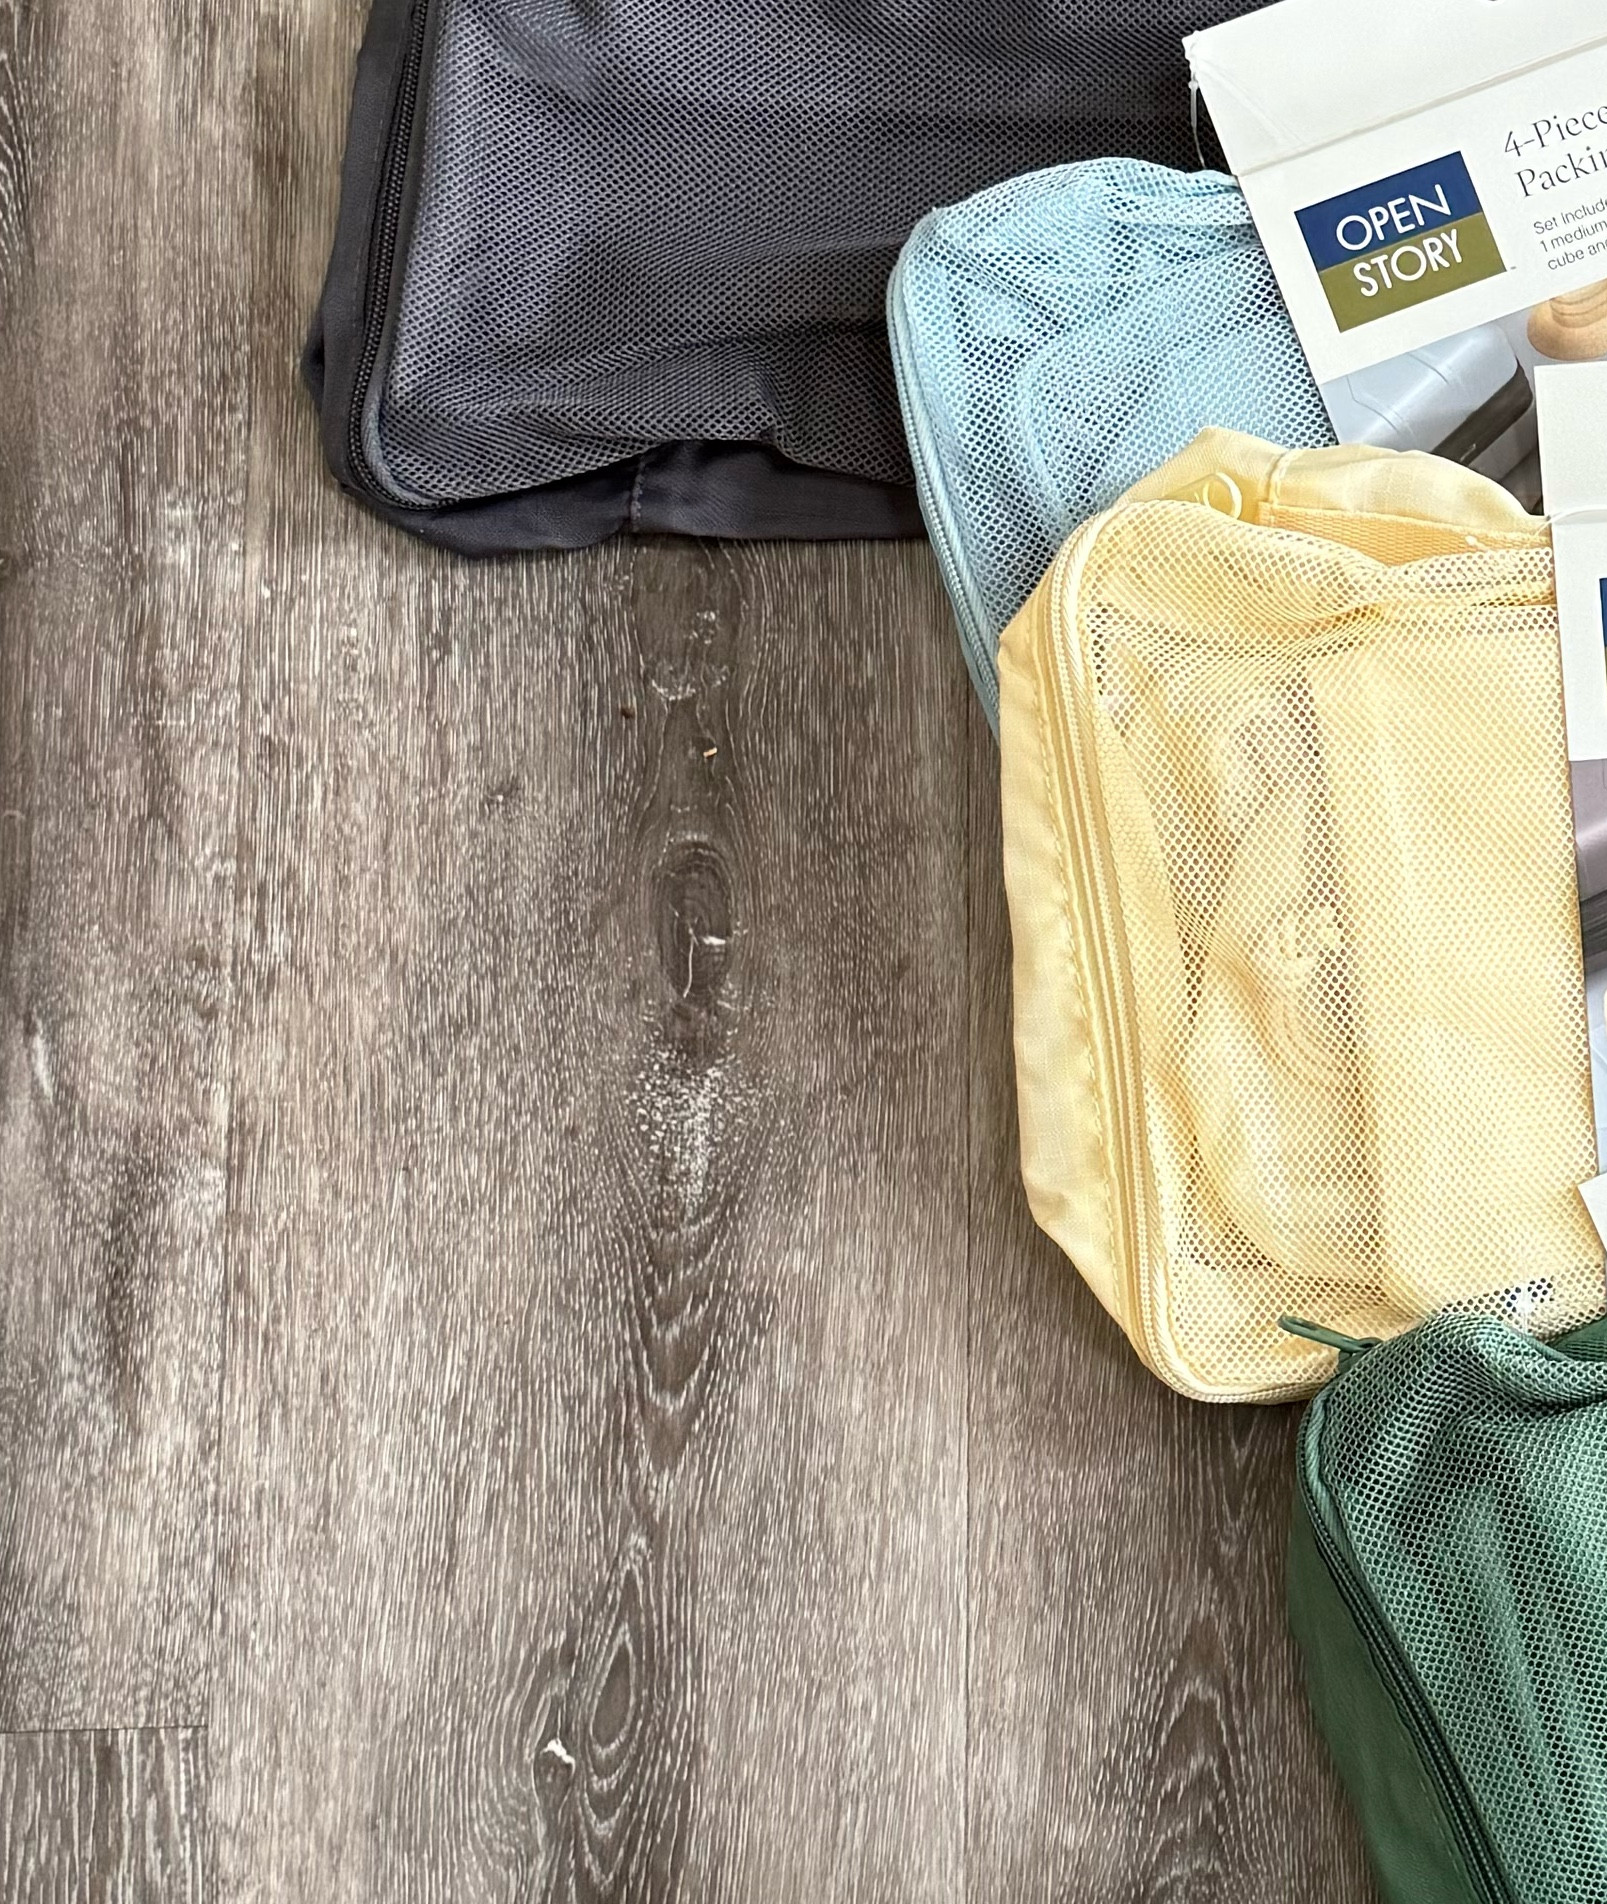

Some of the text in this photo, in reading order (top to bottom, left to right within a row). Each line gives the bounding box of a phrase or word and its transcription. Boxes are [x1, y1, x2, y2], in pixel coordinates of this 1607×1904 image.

[1336, 184, 1451, 250] OPEN
[1533, 216, 1558, 234] Set
[1540, 240, 1548, 252] 1
[1550, 220, 1607, 249] medium
[1353, 229, 1462, 297] STORY
[1547, 249, 1584, 270] cube
